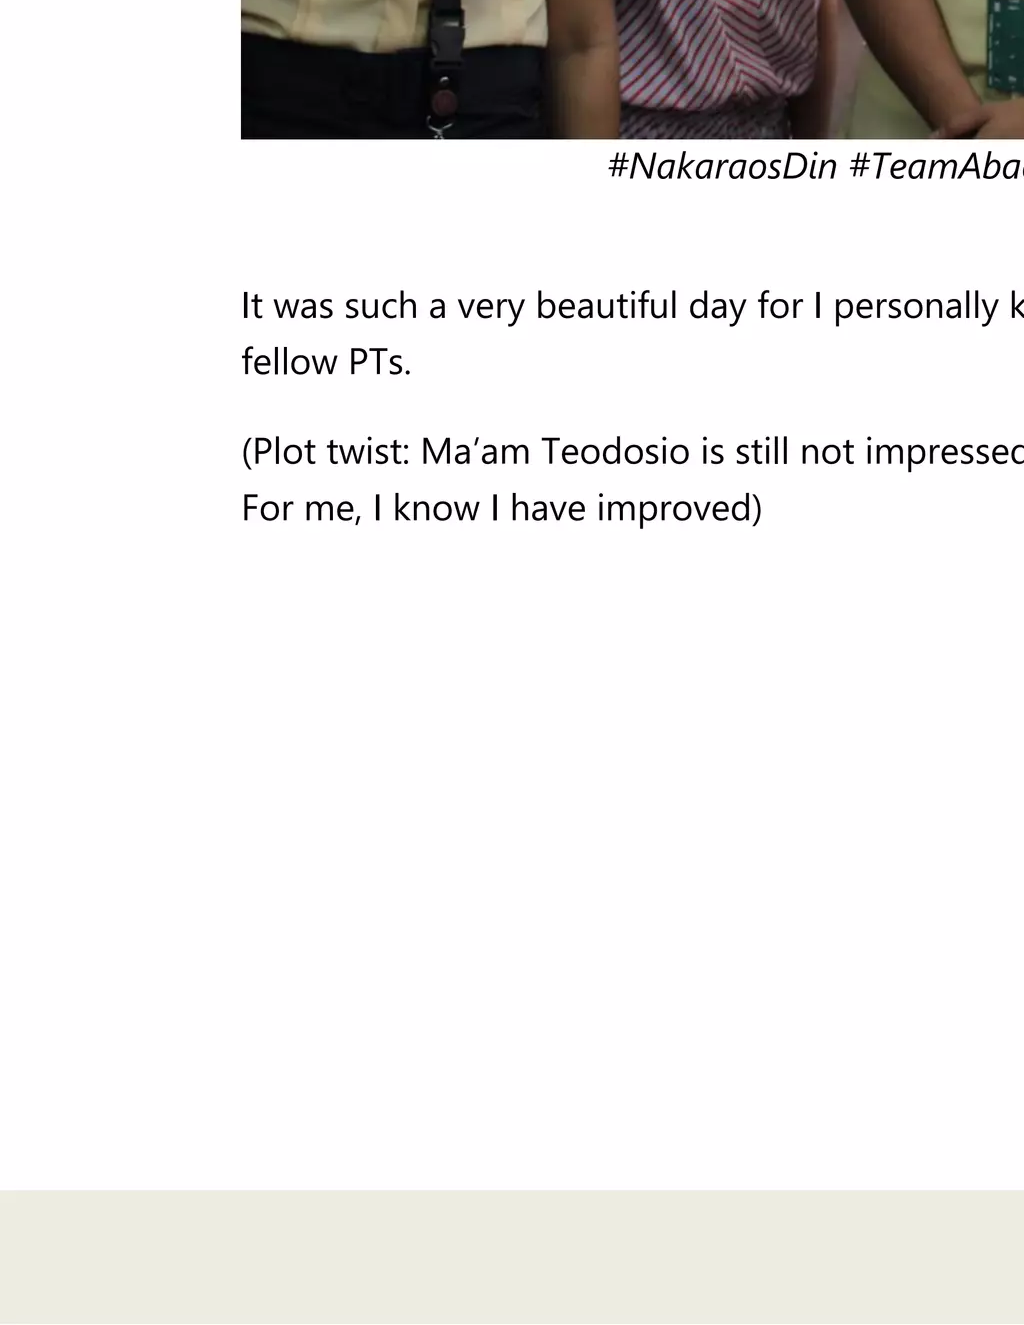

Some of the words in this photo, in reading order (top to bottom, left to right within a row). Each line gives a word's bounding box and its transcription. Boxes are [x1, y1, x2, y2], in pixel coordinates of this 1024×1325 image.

[607, 150, 837, 180] #NakaraosDin
[243, 291, 264, 320] It
[273, 298, 334, 320] was
[345, 289, 417, 320] such
[429, 298, 446, 320] a
[457, 298, 526, 328] very
[537, 289, 677, 320] beautiful
[689, 289, 748, 328] day
[757, 289, 804, 320] for
[814, 291, 822, 319] I
[835, 289, 1000, 328] personally
[241, 345, 339, 376] fellow
[350, 347, 411, 376] PTs.
[242, 435, 317, 471] (Plot
[326, 435, 409, 465] twist:
[541, 435, 690, 465] Teodosio
[702, 435, 725, 465] is
[736, 435, 788, 465] still
[801, 439, 855, 465] not
[243, 493, 295, 522] For
[305, 500, 361, 526] me,
[374, 493, 382, 522] I
[394, 492, 481, 522] know
[491, 493, 499, 522] I
[511, 492, 586, 522] have
[598, 492, 762, 530] improved)
